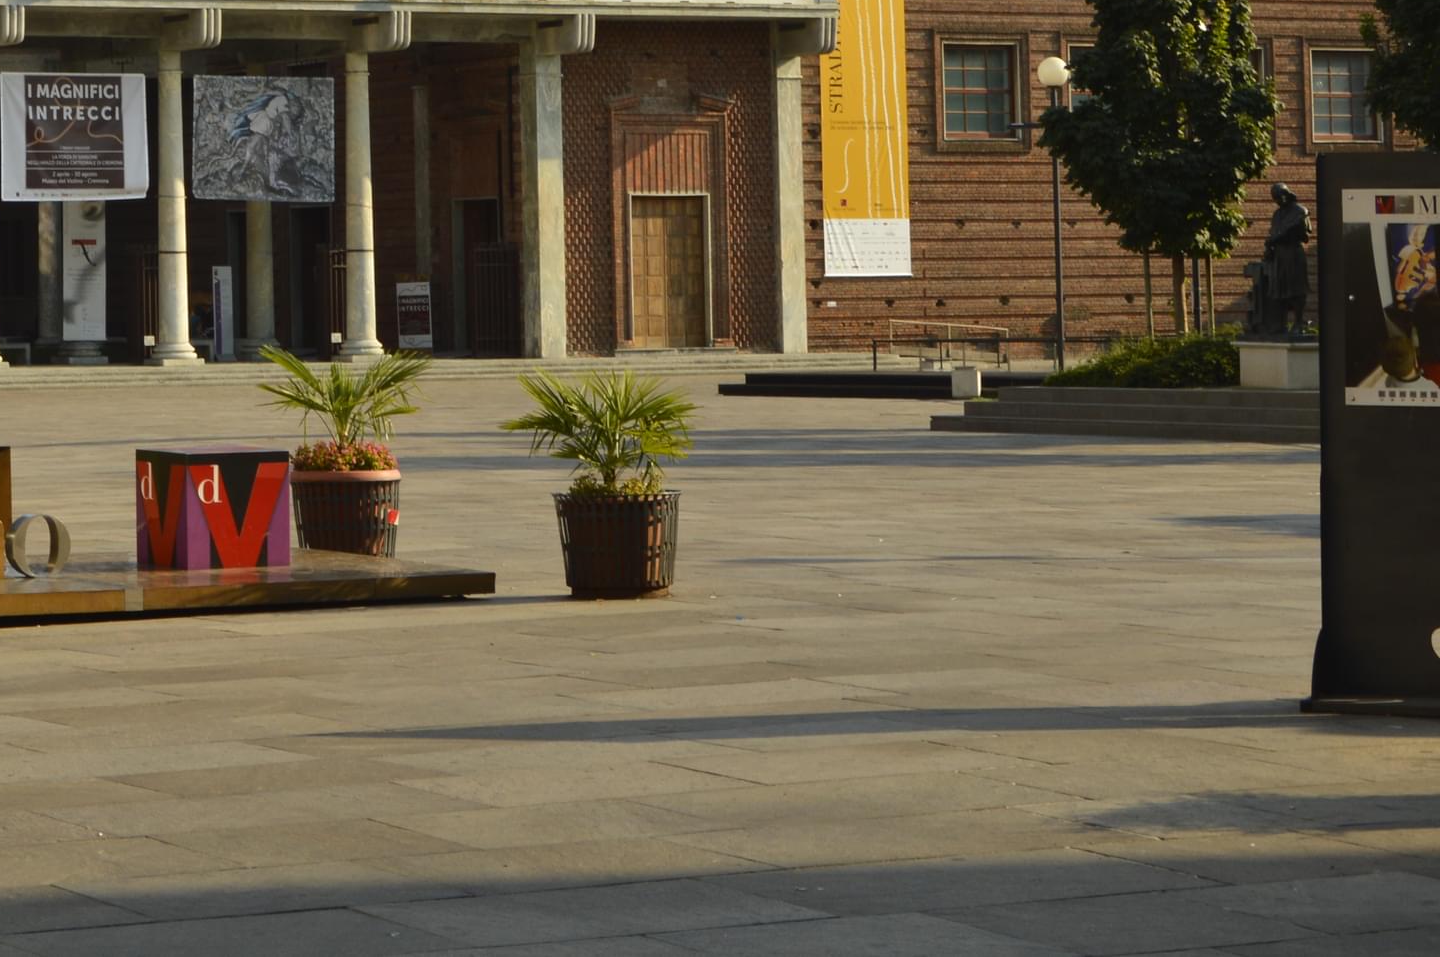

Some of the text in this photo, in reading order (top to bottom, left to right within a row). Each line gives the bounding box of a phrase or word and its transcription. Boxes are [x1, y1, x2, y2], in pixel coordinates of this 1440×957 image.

[27, 83, 119, 99] I MAGNIFICI
[28, 106, 120, 121] INTRECCI
